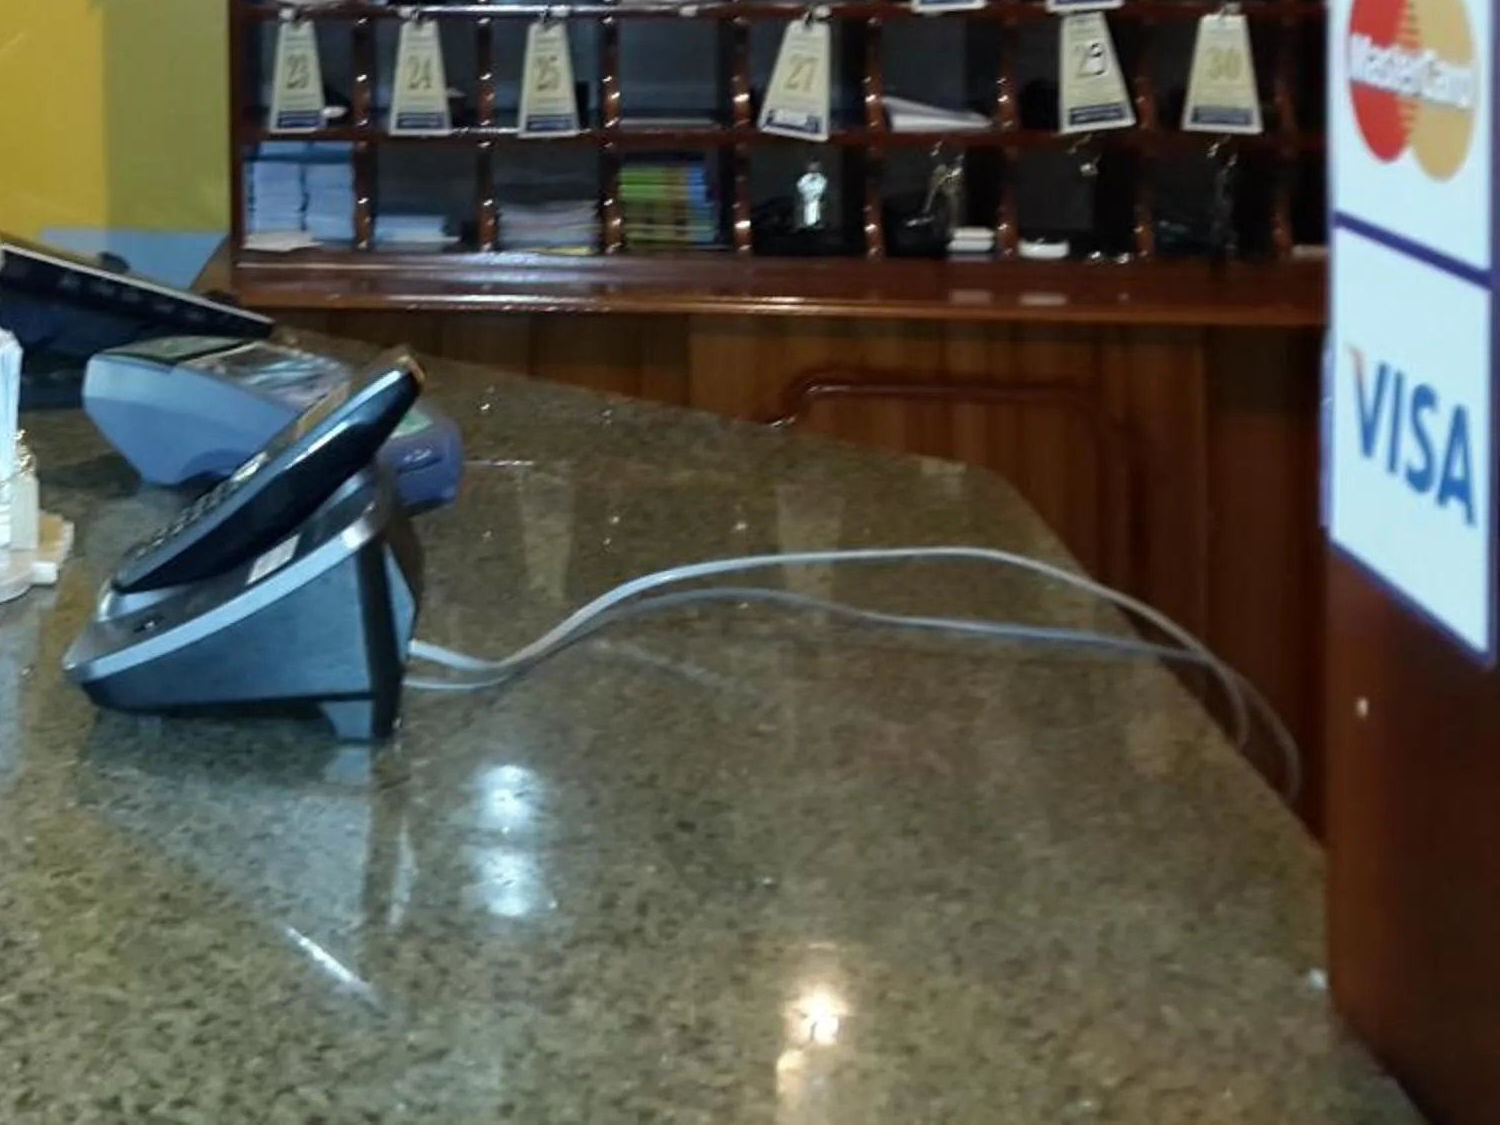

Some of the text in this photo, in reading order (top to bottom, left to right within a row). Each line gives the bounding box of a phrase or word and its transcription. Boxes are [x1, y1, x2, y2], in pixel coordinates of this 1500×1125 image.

[285, 54, 310, 90] 23
[406, 54, 432, 90] 24
[783, 52, 819, 93] 27
[1346, 343, 1476, 528] VISA
